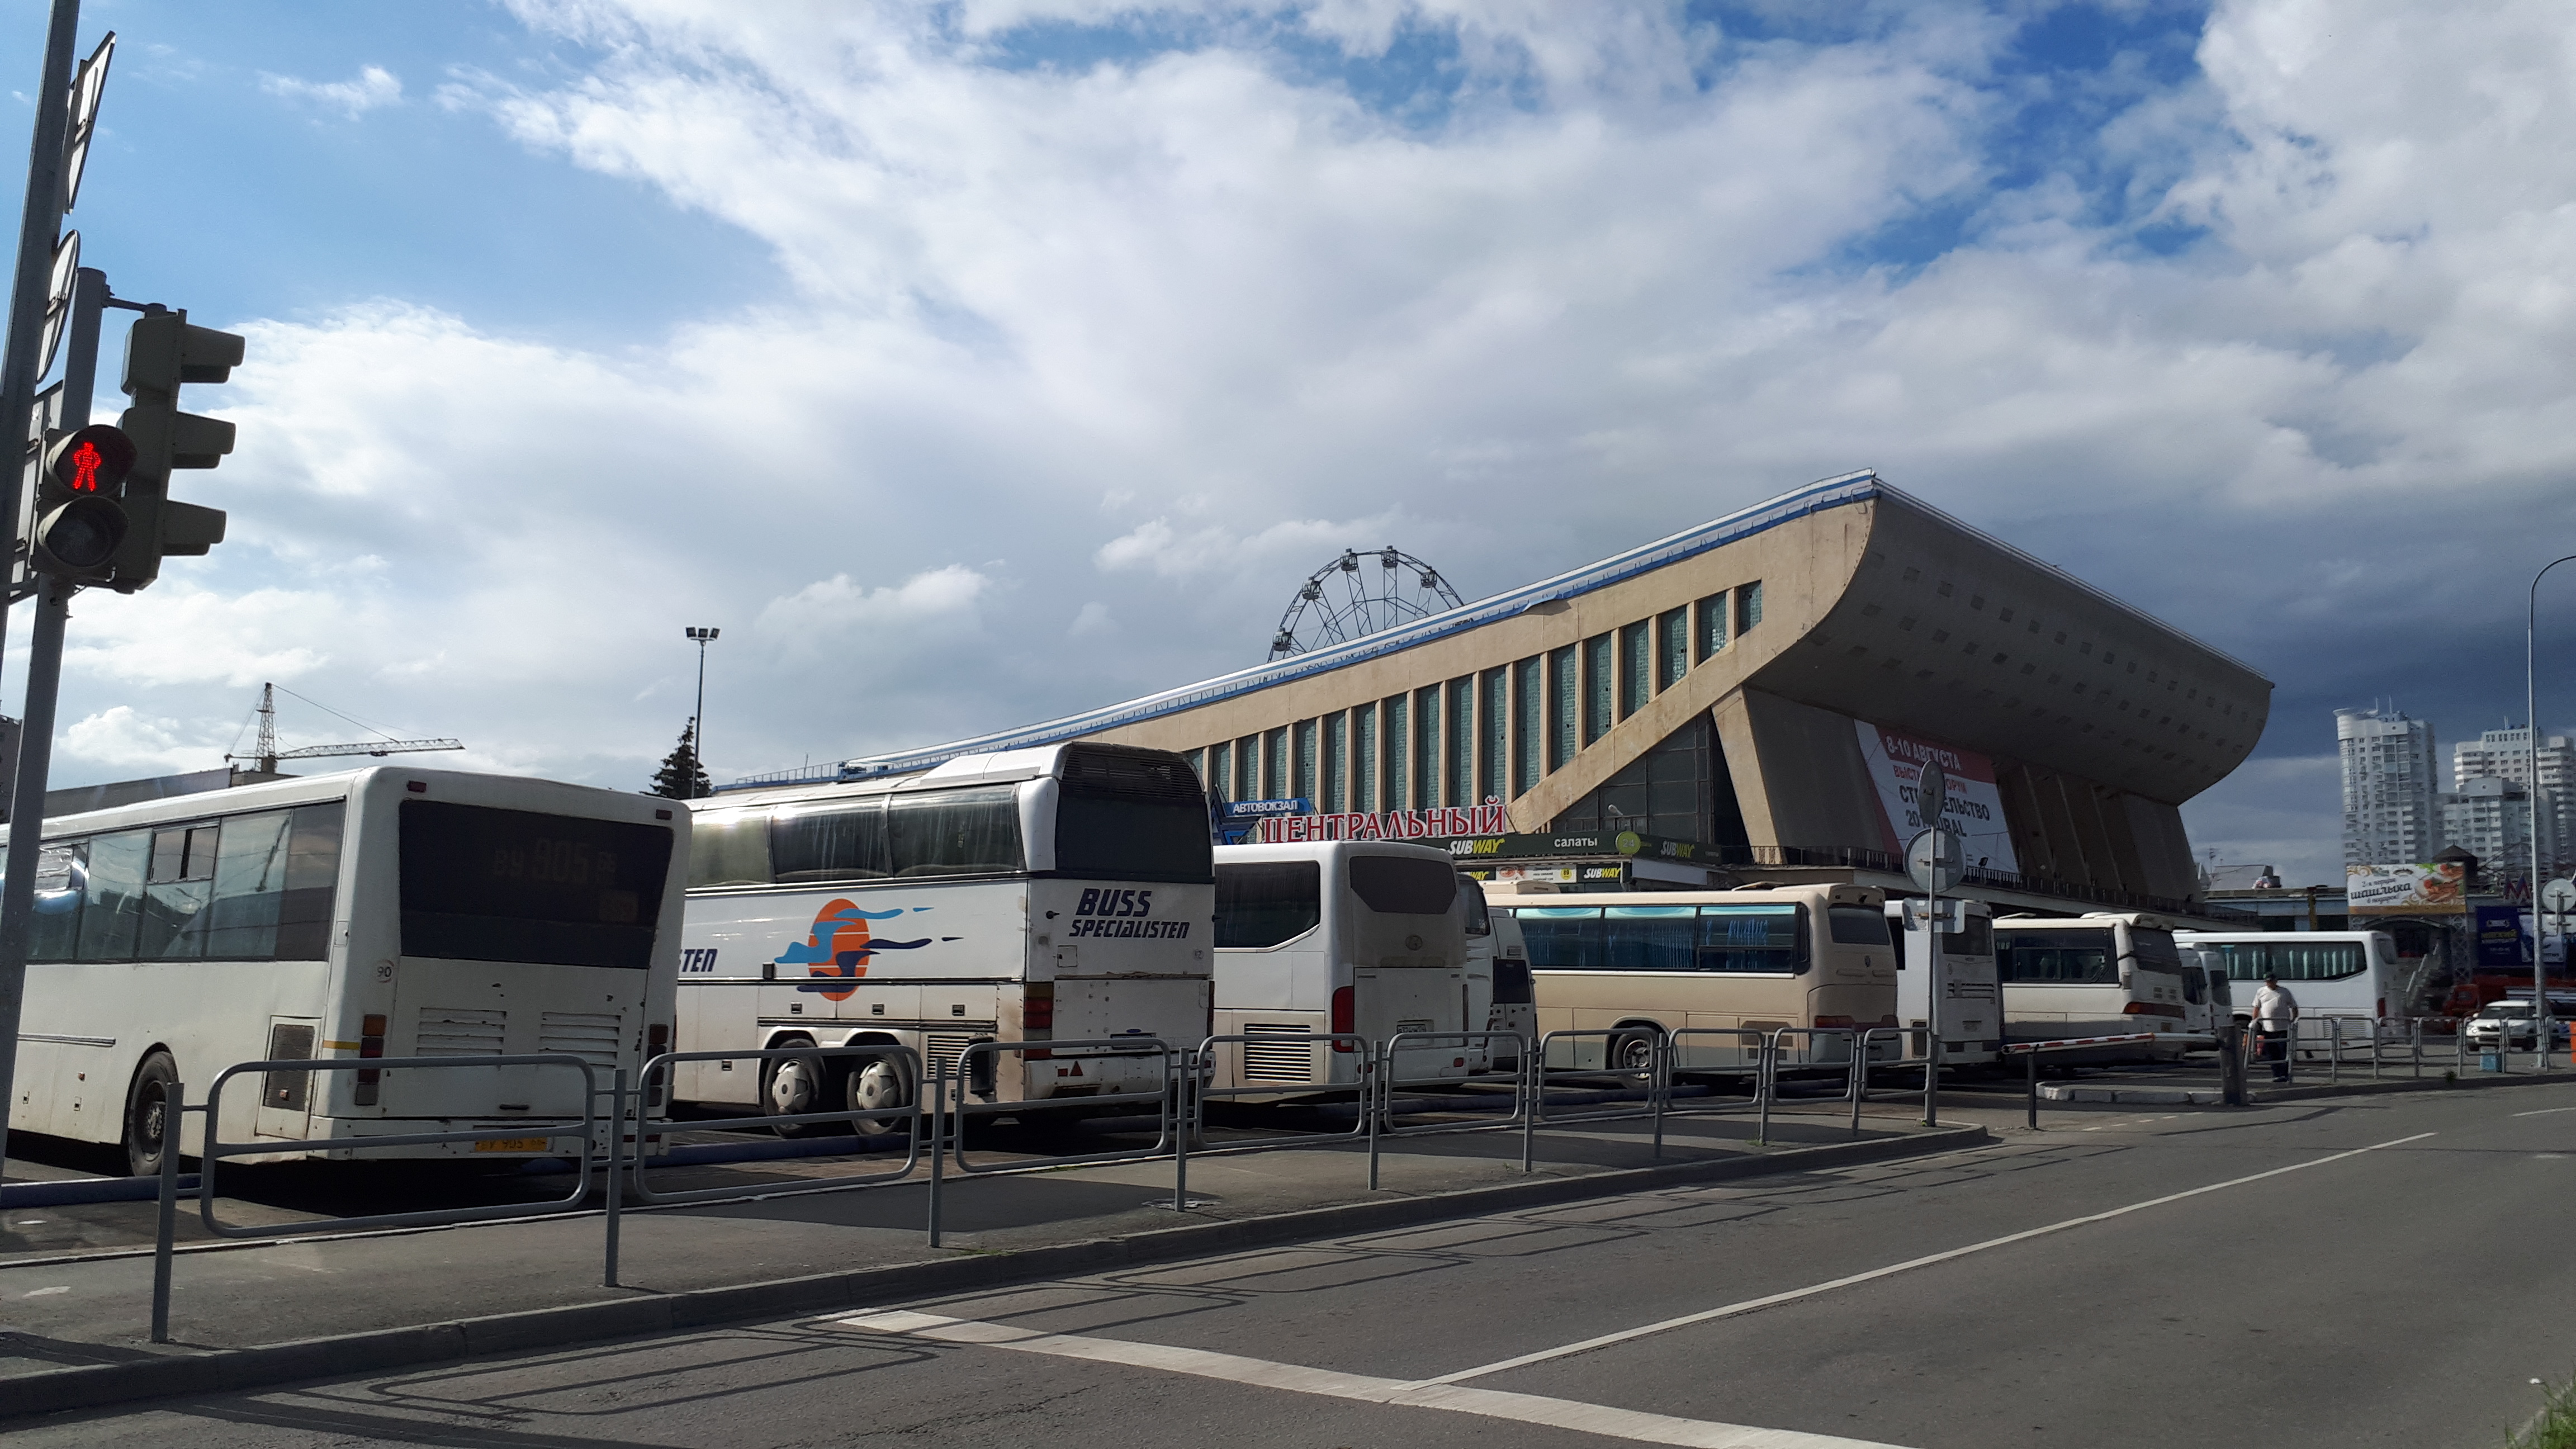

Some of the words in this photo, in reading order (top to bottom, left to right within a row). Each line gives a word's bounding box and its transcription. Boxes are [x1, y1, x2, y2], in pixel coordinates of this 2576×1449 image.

[1885, 735, 1911, 757] 8-10
[1912, 743, 1962, 771] АВГУСТА
[1232, 799, 1298, 814] АВТОВОКЗАЛ
[1898, 784, 1990, 821] СТЕЛЬСТВО
[1262, 794, 1507, 844] ЦЕНТРАЛЬНЫЙ
[1446, 837, 1505, 855] SUBWAY
[1554, 836, 1598, 848] салаты
[1622, 838, 1635, 847] 24
[1660, 840, 1696, 858] SUBWAY
[1583, 868, 1621, 879] SUBWAY
[2350, 883, 2413, 899] шашлыка
[1075, 888, 1153, 917] BUSS
[377, 966, 392, 977] 90
